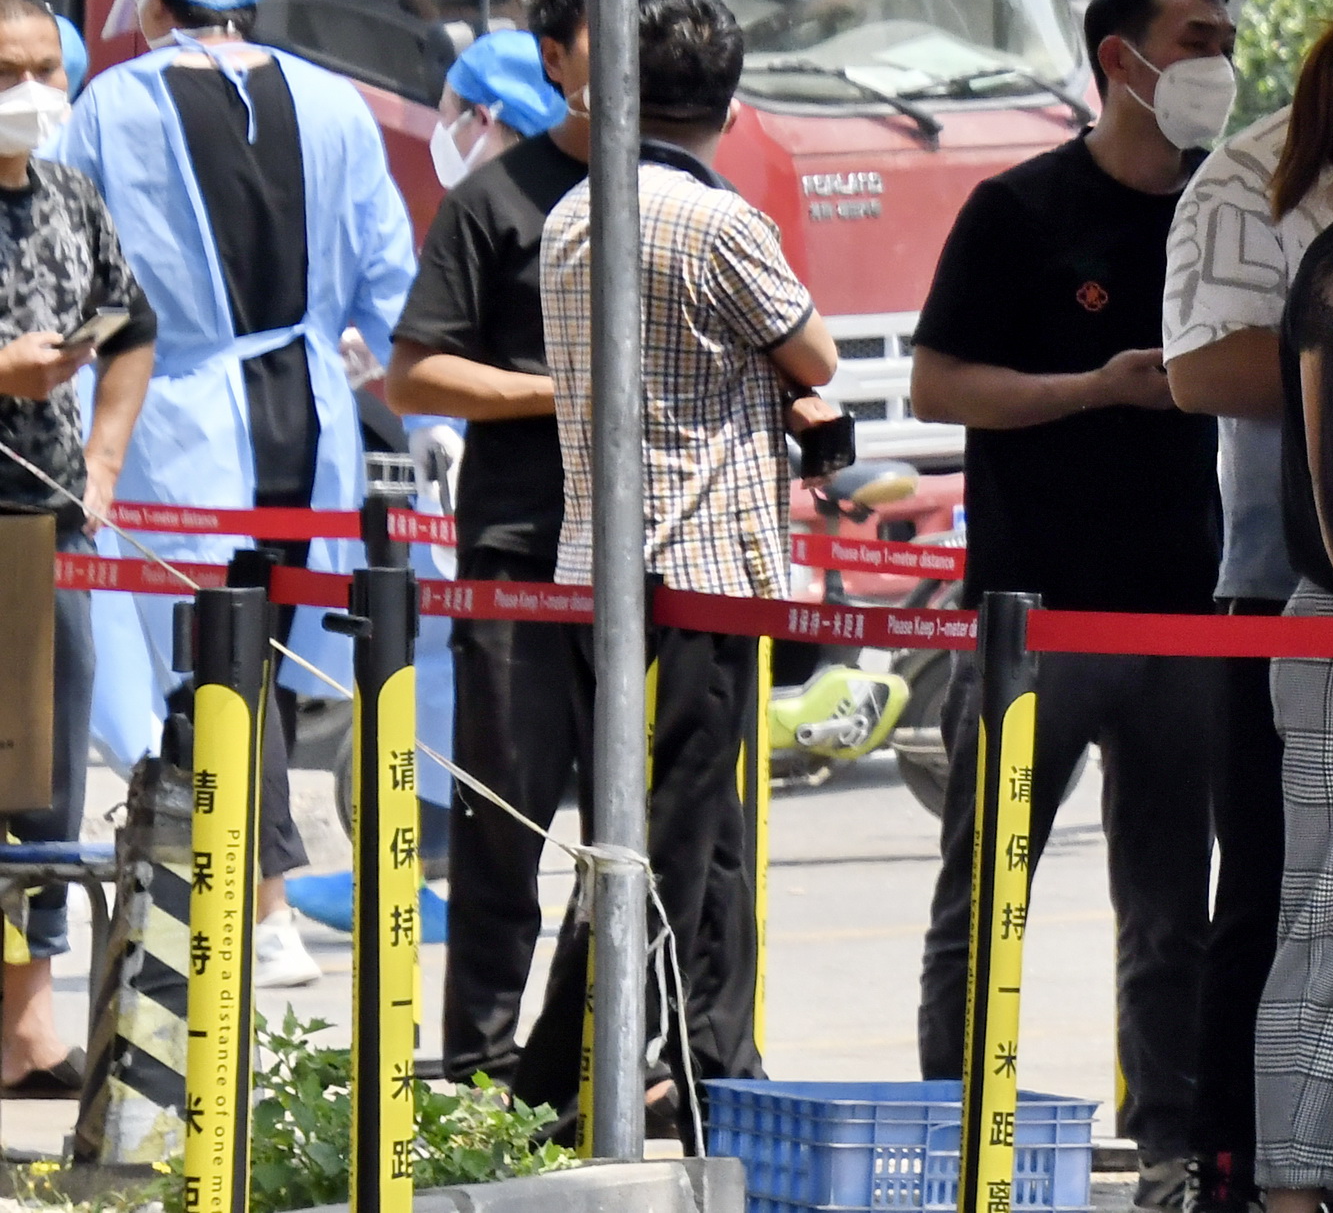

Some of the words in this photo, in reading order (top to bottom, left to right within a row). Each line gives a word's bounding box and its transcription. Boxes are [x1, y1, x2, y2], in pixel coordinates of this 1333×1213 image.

[832, 542, 858, 561] Please
[860, 546, 881, 565] Keep
[884, 547, 917, 567] 1-meter
[920, 551, 954, 570] distance
[789, 608, 864, 638] 请保持一米距离
[888, 615, 912, 634] Please
[914, 617, 934, 639] Keep
[936, 618, 969, 636] 1-meter
[226, 829, 241, 900] Please
[219, 909, 237, 968] keep
[216, 986, 233, 1088] distance
[215, 1094, 231, 1118] of
[213, 1126, 225, 1166] one
[210, 1176, 223, 1213] me
